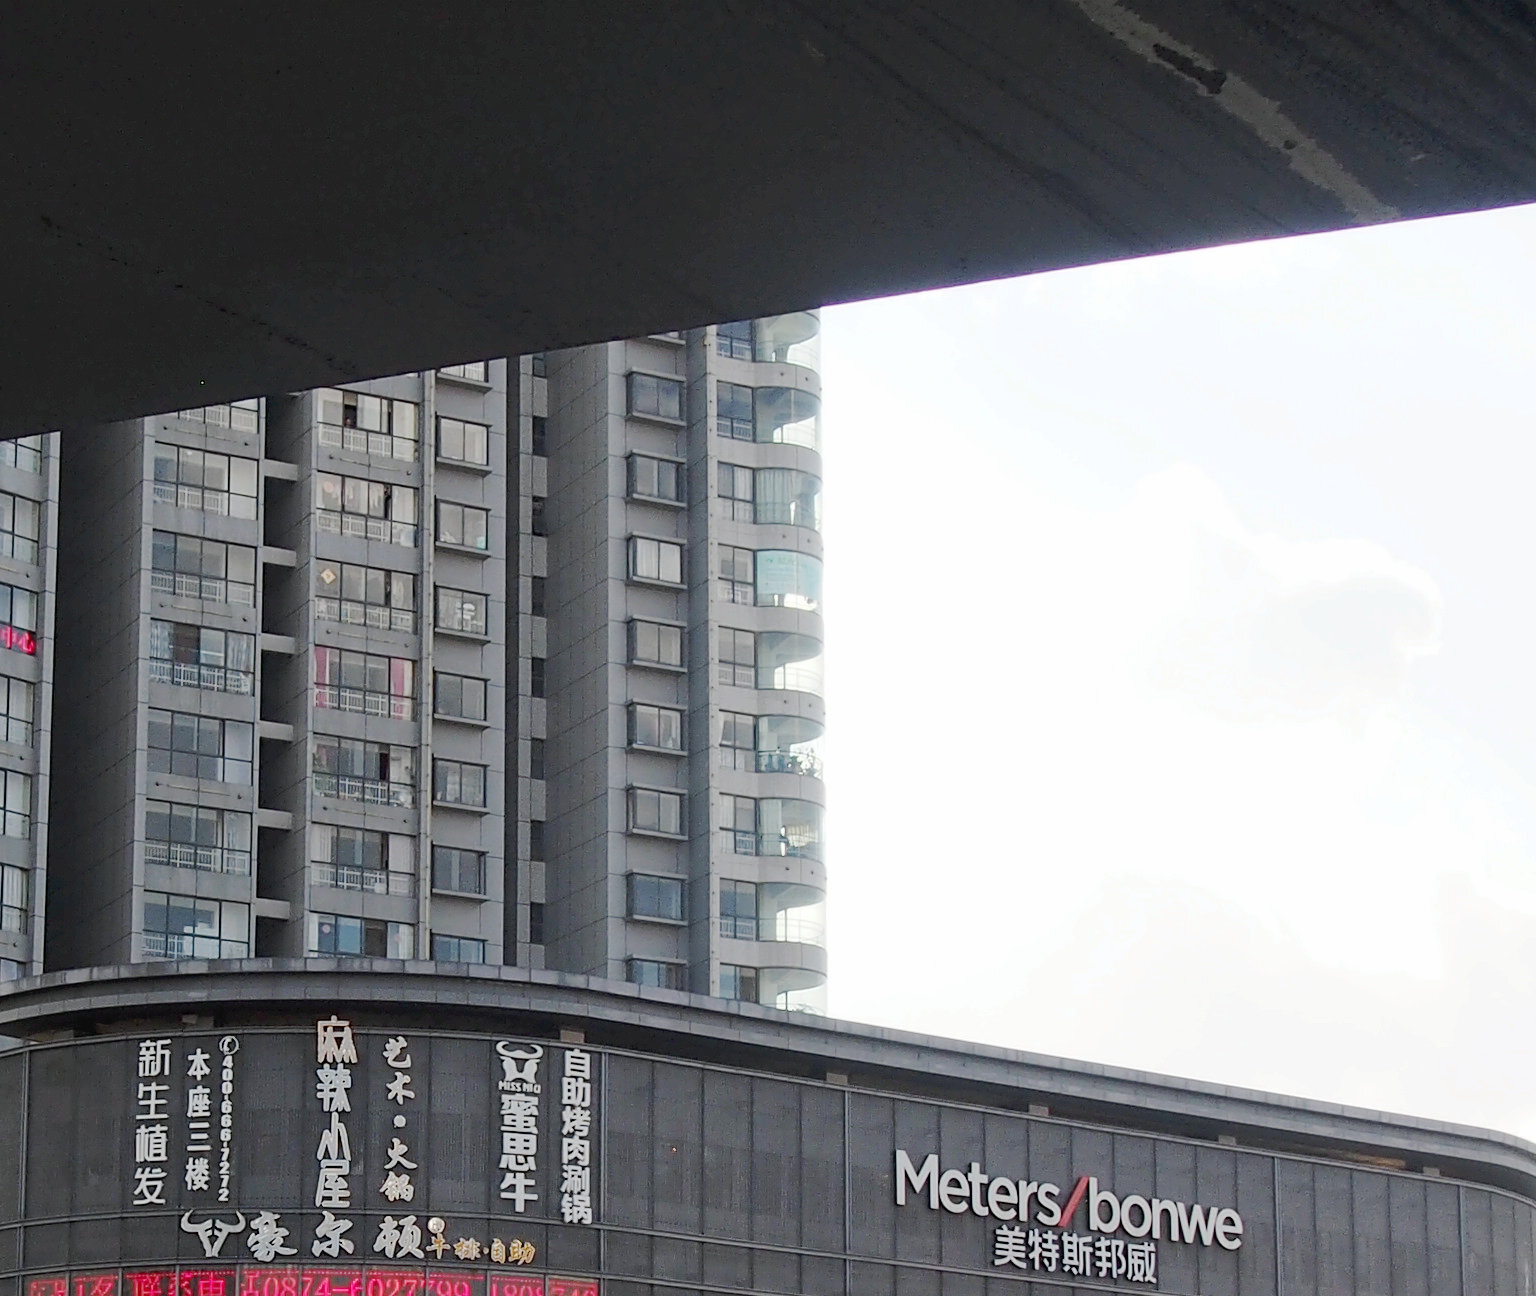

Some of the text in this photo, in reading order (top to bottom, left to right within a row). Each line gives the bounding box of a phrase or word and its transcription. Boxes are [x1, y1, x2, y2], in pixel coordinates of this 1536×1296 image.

[133, 1038, 173, 1206] 新生植发
[184, 1048, 213, 1192] 本座三楼
[314, 1014, 359, 1209] 麻辣小屋
[500, 1093, 539, 1214] 蜜思牛
[559, 1048, 593, 1225] 自助烤肉涮锅
[246, 1210, 425, 1263] 豪尔顿
[895, 1149, 1244, 1251] Meters/bonwe
[993, 1225, 1158, 1285] 美特斯邦威
